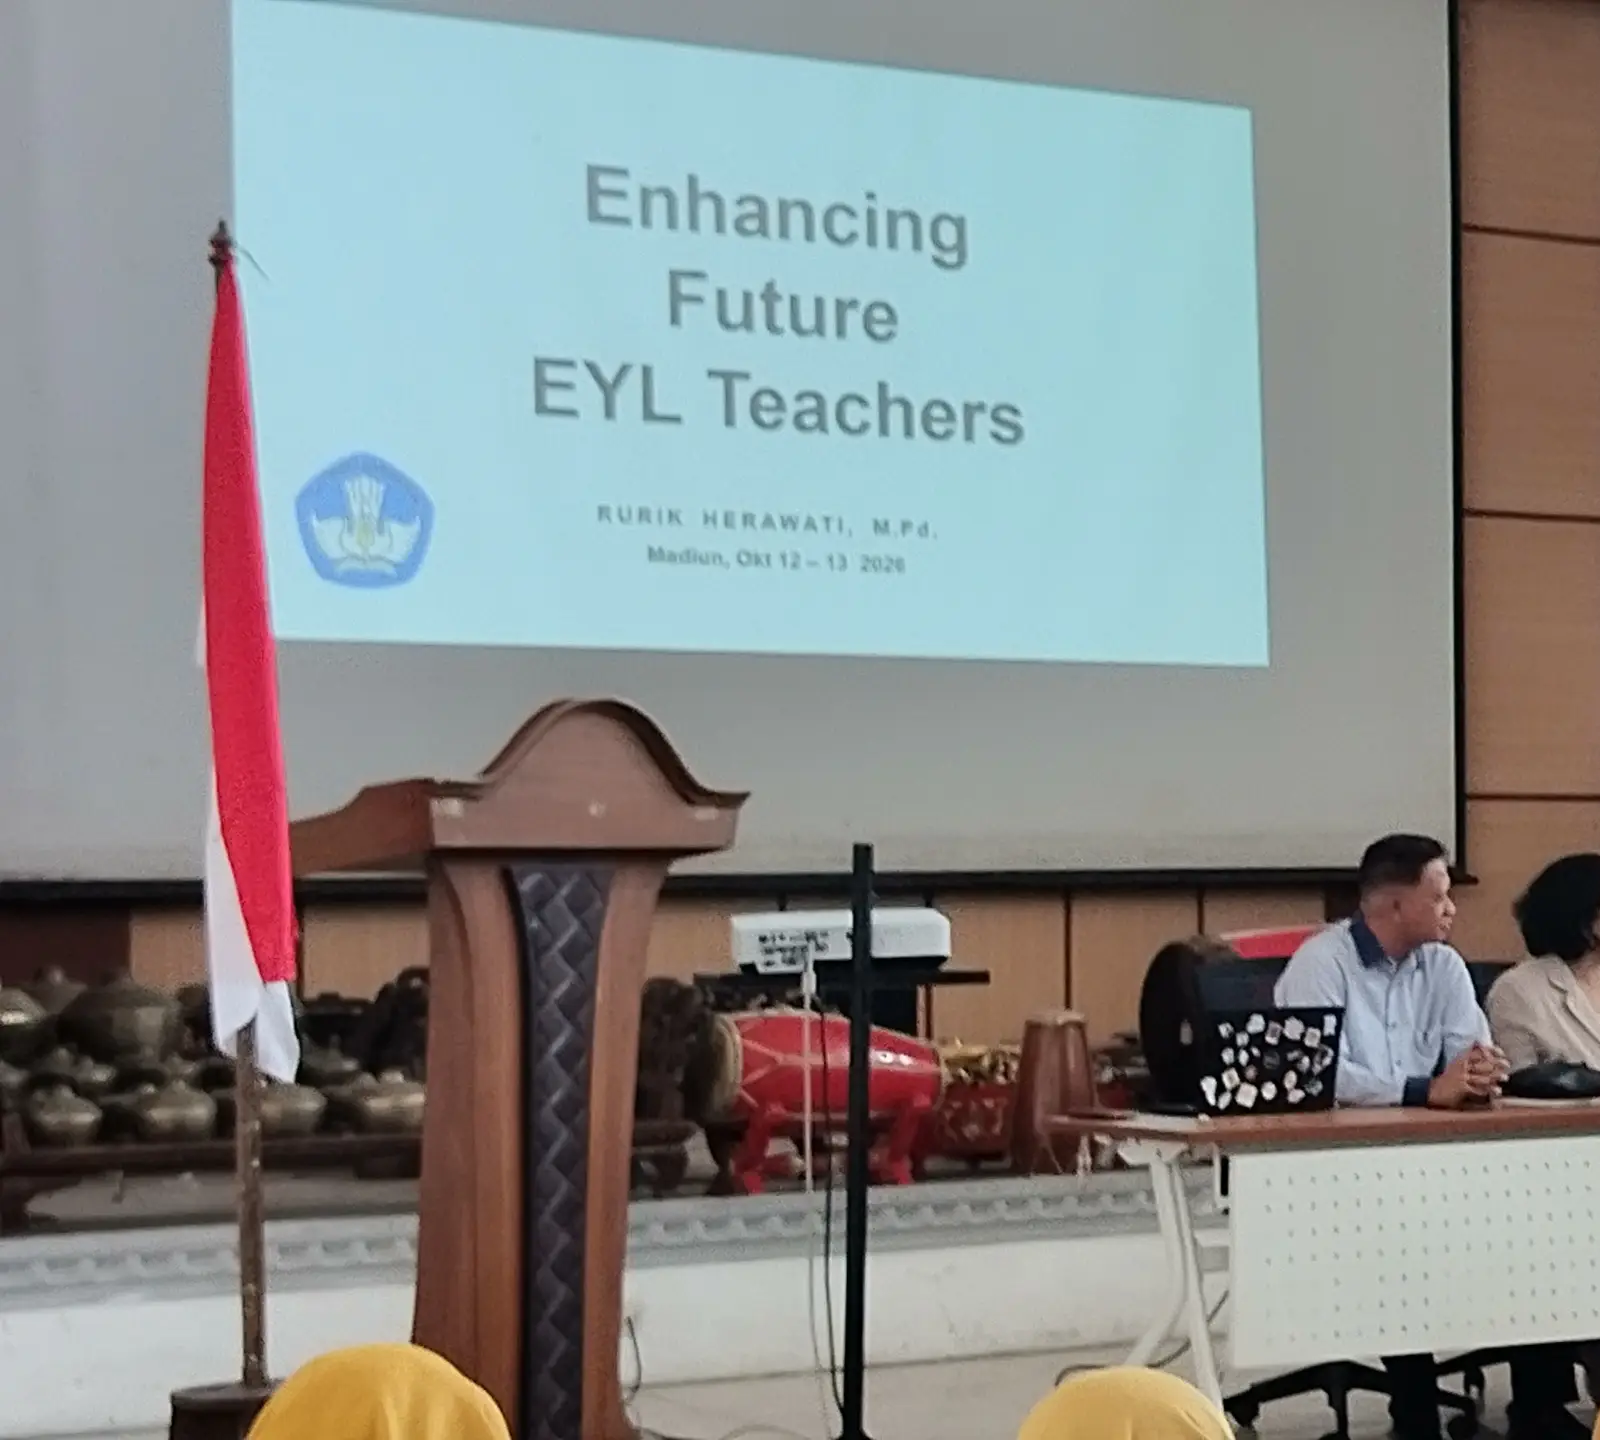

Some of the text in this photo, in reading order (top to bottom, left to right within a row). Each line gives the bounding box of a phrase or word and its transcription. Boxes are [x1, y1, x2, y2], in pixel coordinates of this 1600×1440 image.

[586, 163, 968, 271] Enhancing
[668, 268, 898, 344] Future
[533, 355, 1025, 447] EYL Teachers
[597, 505, 937, 540] RURIK HERAWATI, M.Pd.
[647, 545, 730, 570] Madiun,
[736, 549, 772, 568] Okt
